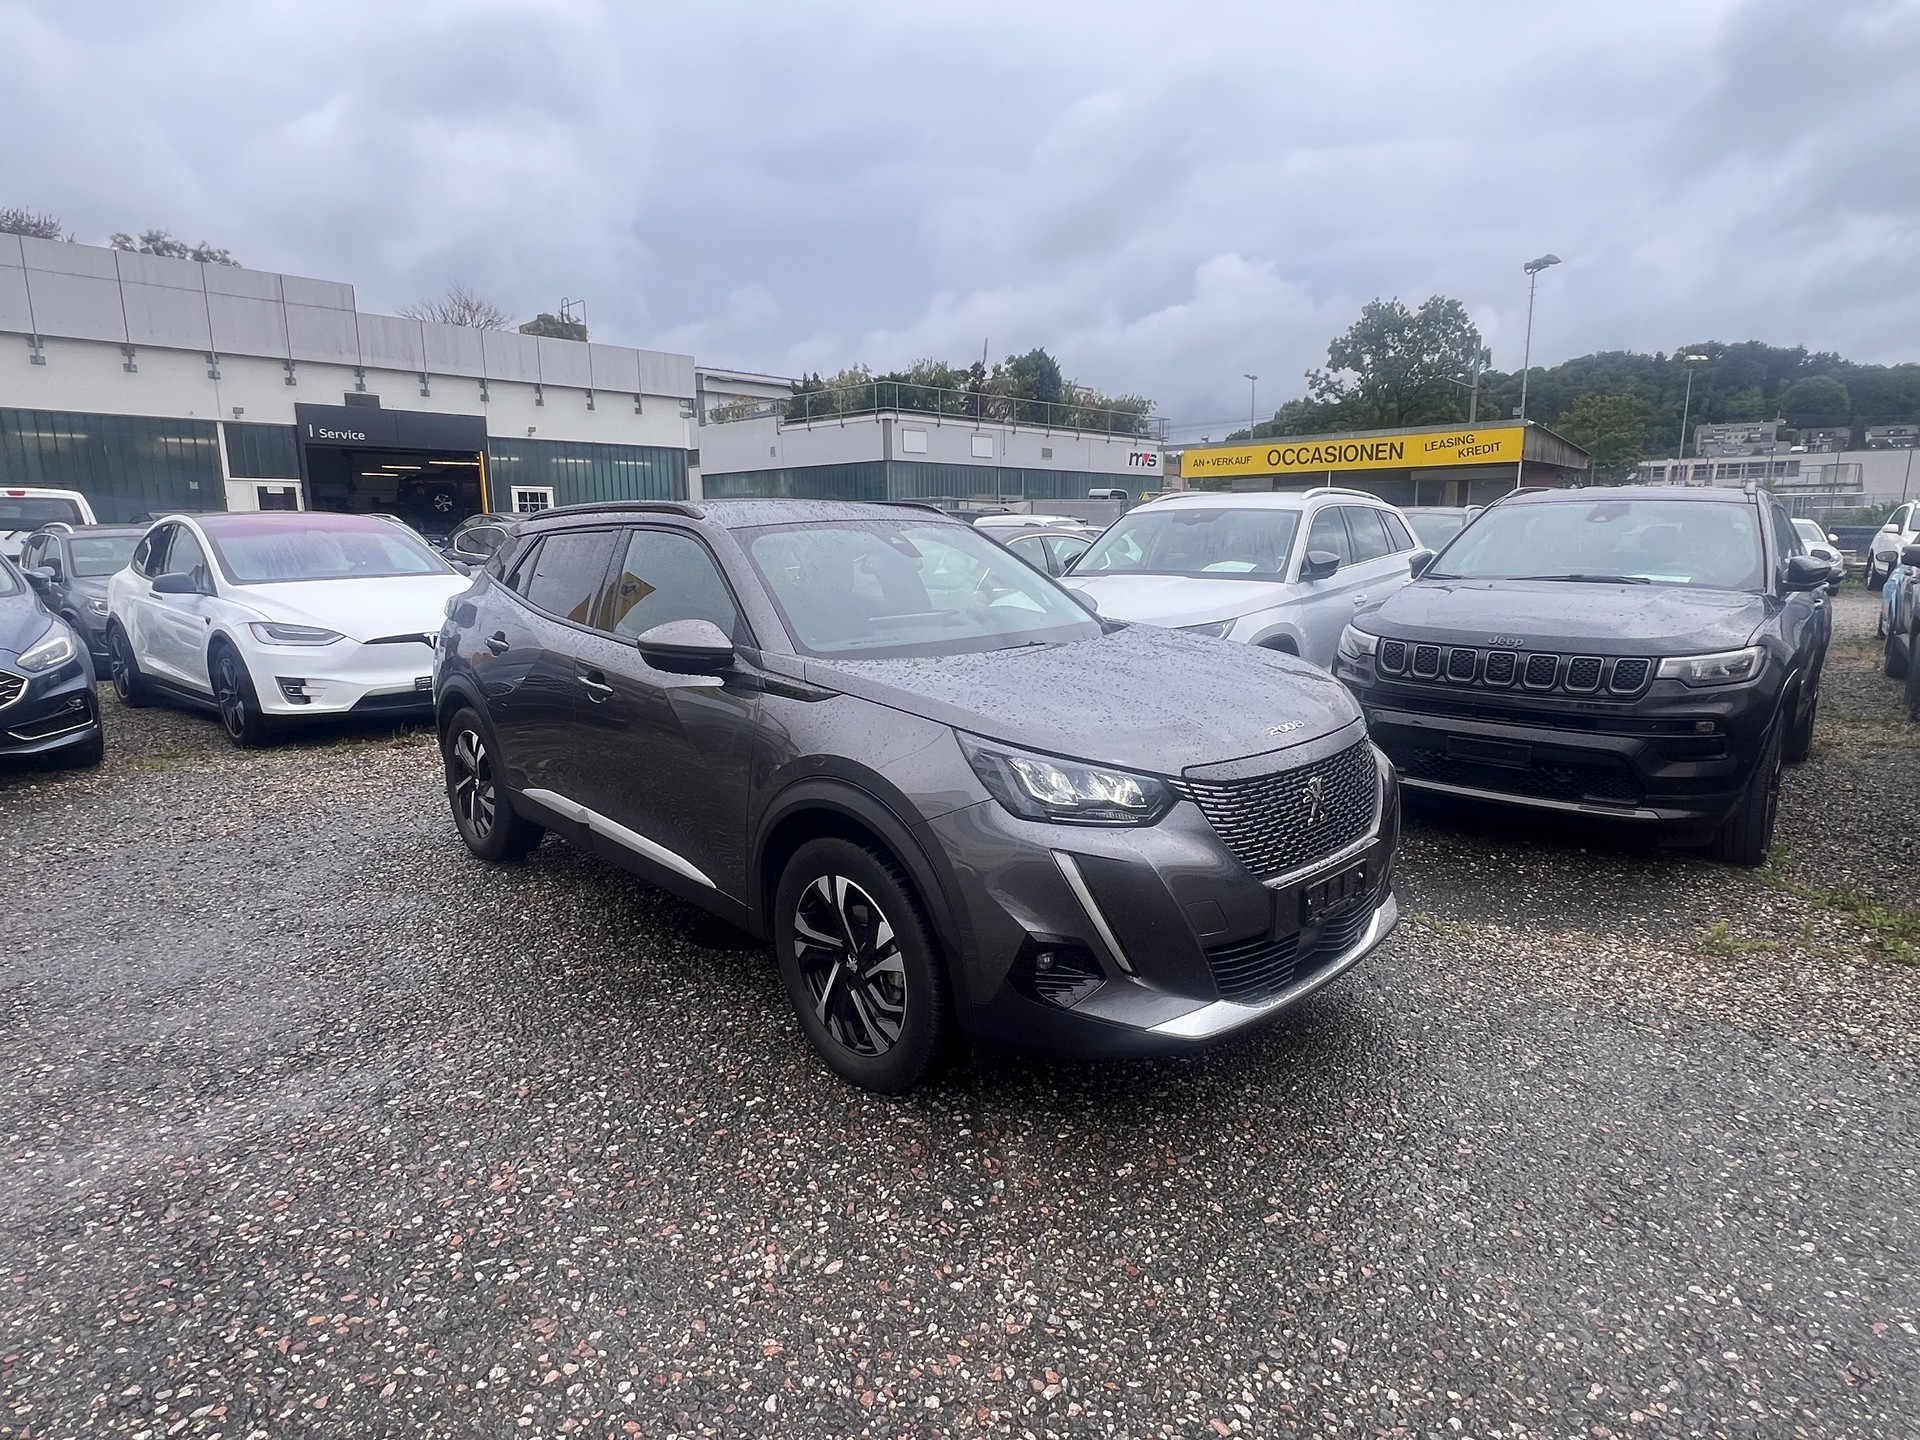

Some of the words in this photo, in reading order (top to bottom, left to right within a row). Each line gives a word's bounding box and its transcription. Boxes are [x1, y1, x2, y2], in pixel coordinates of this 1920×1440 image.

[319, 428, 366, 440] Service
[1424, 434, 1475, 452] LEASING
[1458, 441, 1502, 458] KREDIT
[1267, 442, 1404, 467] OCCASIONEN
[1488, 635, 1524, 649] Jeep
[1266, 719, 1305, 736] 2008
